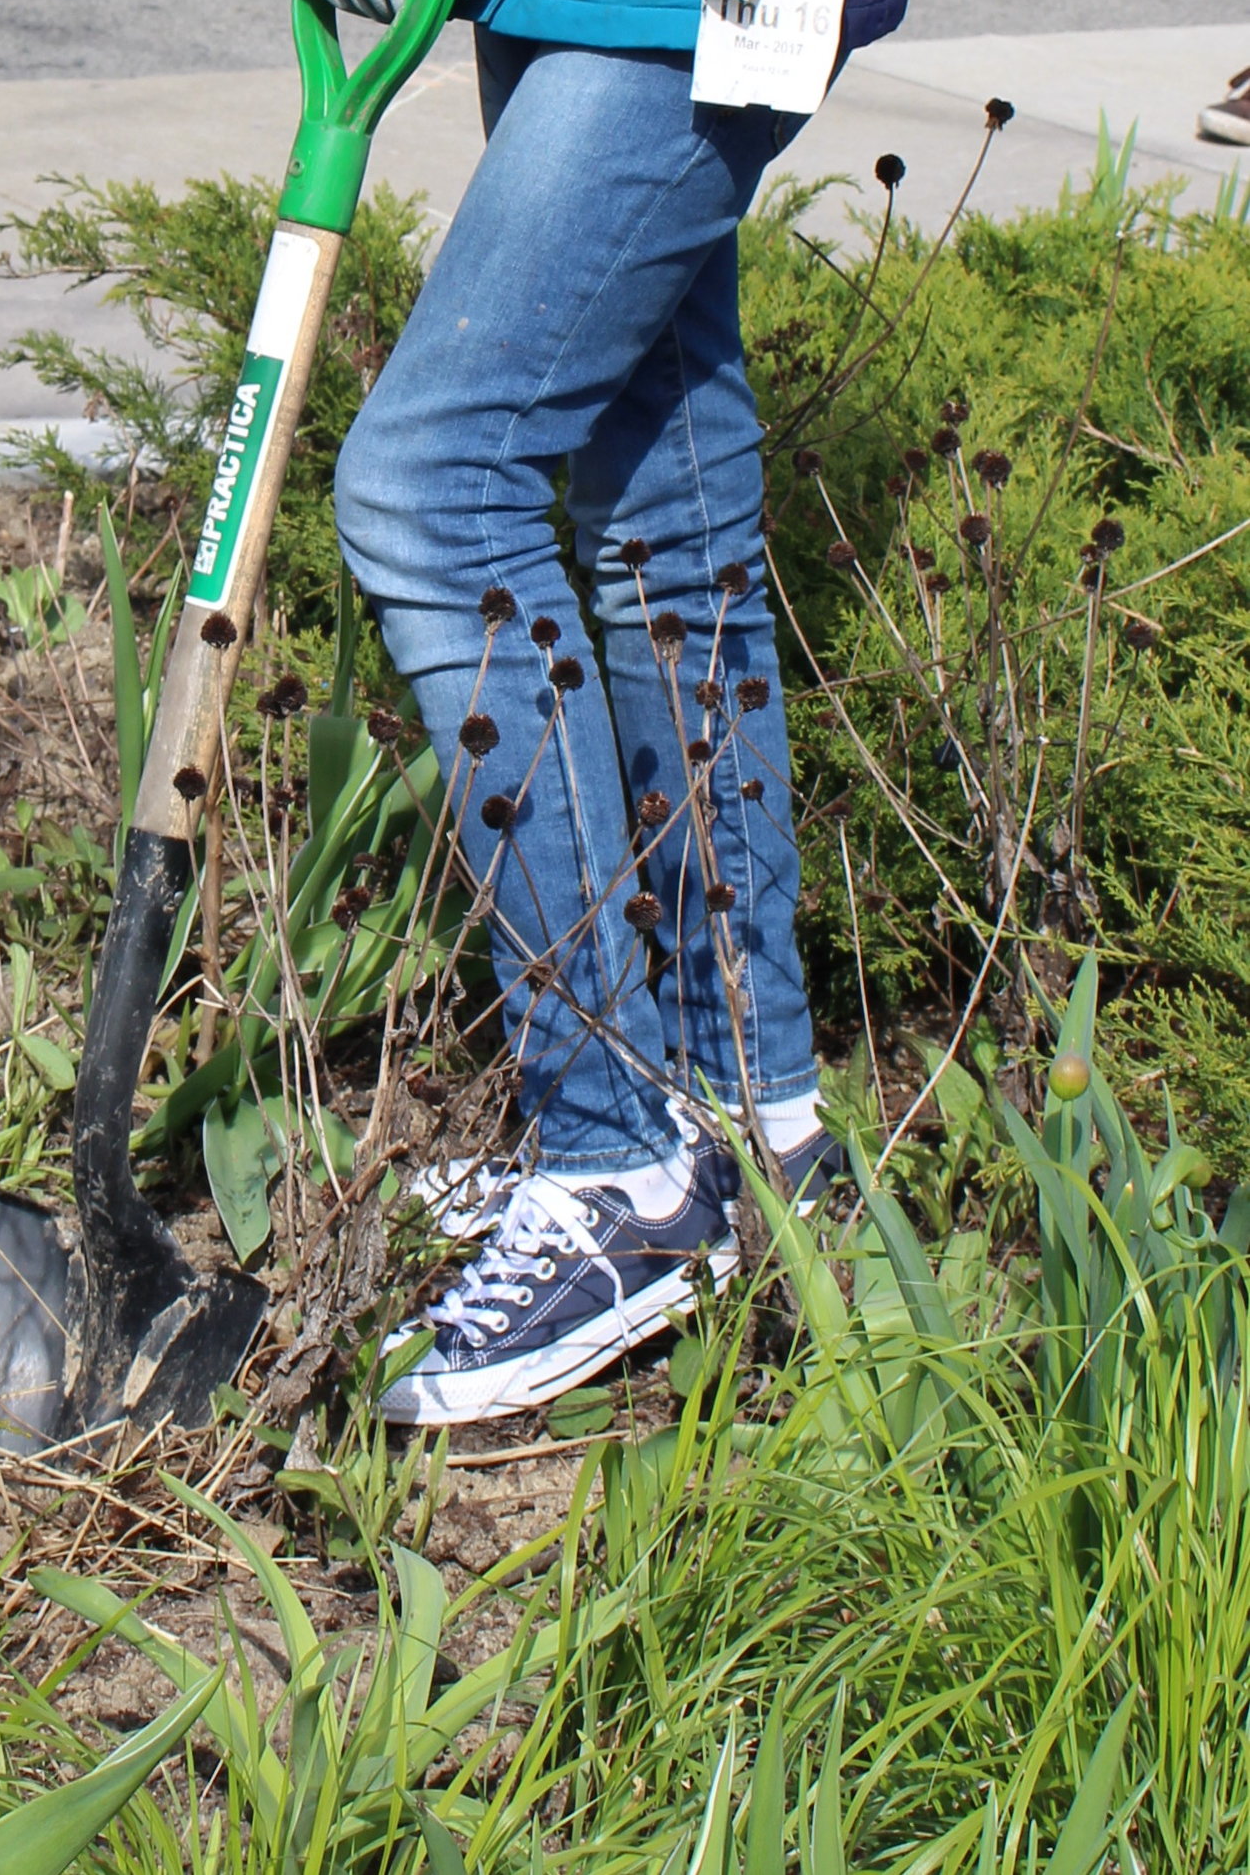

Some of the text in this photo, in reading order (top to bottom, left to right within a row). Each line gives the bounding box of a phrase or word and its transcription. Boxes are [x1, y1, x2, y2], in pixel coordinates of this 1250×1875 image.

[794, 1, 832, 36] 16
[734, 34, 760, 51] Mar
[202, 382, 261, 541] PRACTICA
